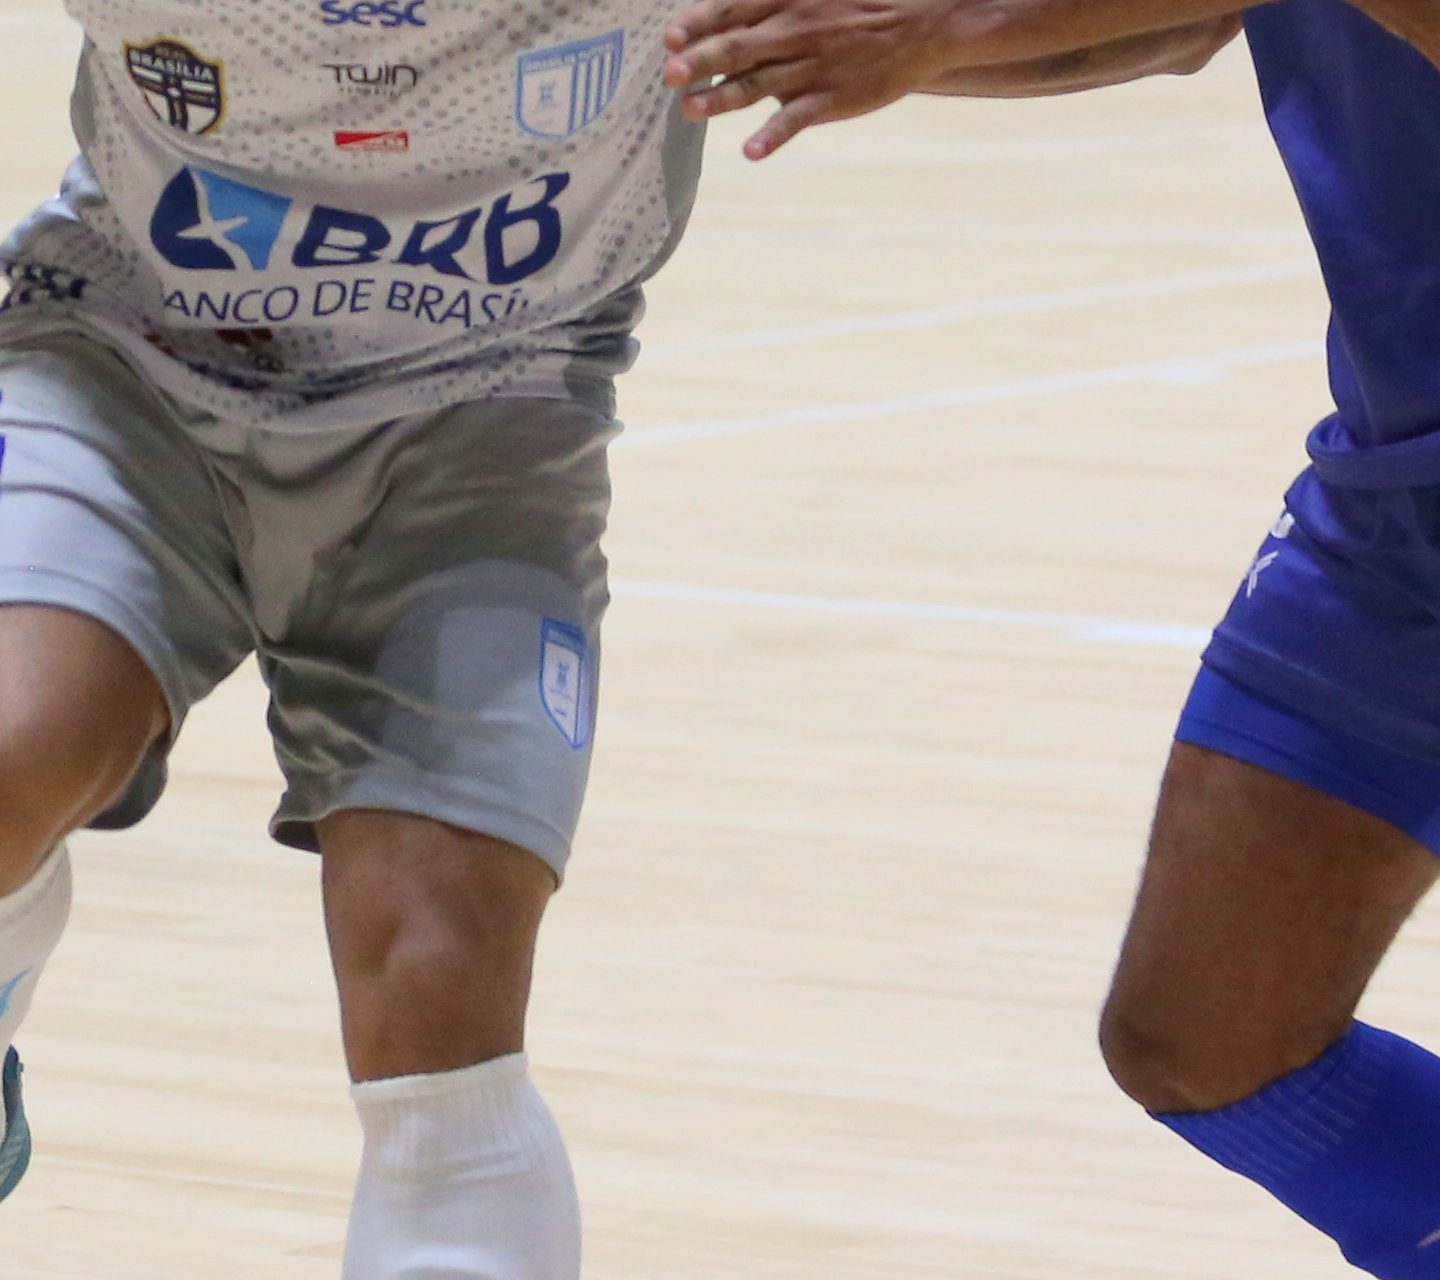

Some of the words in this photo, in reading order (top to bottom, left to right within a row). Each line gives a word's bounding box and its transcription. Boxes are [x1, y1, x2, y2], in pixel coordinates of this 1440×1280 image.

[292, 171, 570, 286] BRB
[163, 285, 300, 323] ANCO
[312, 279, 375, 317] DE
[385, 279, 530, 329] BRASÍ
